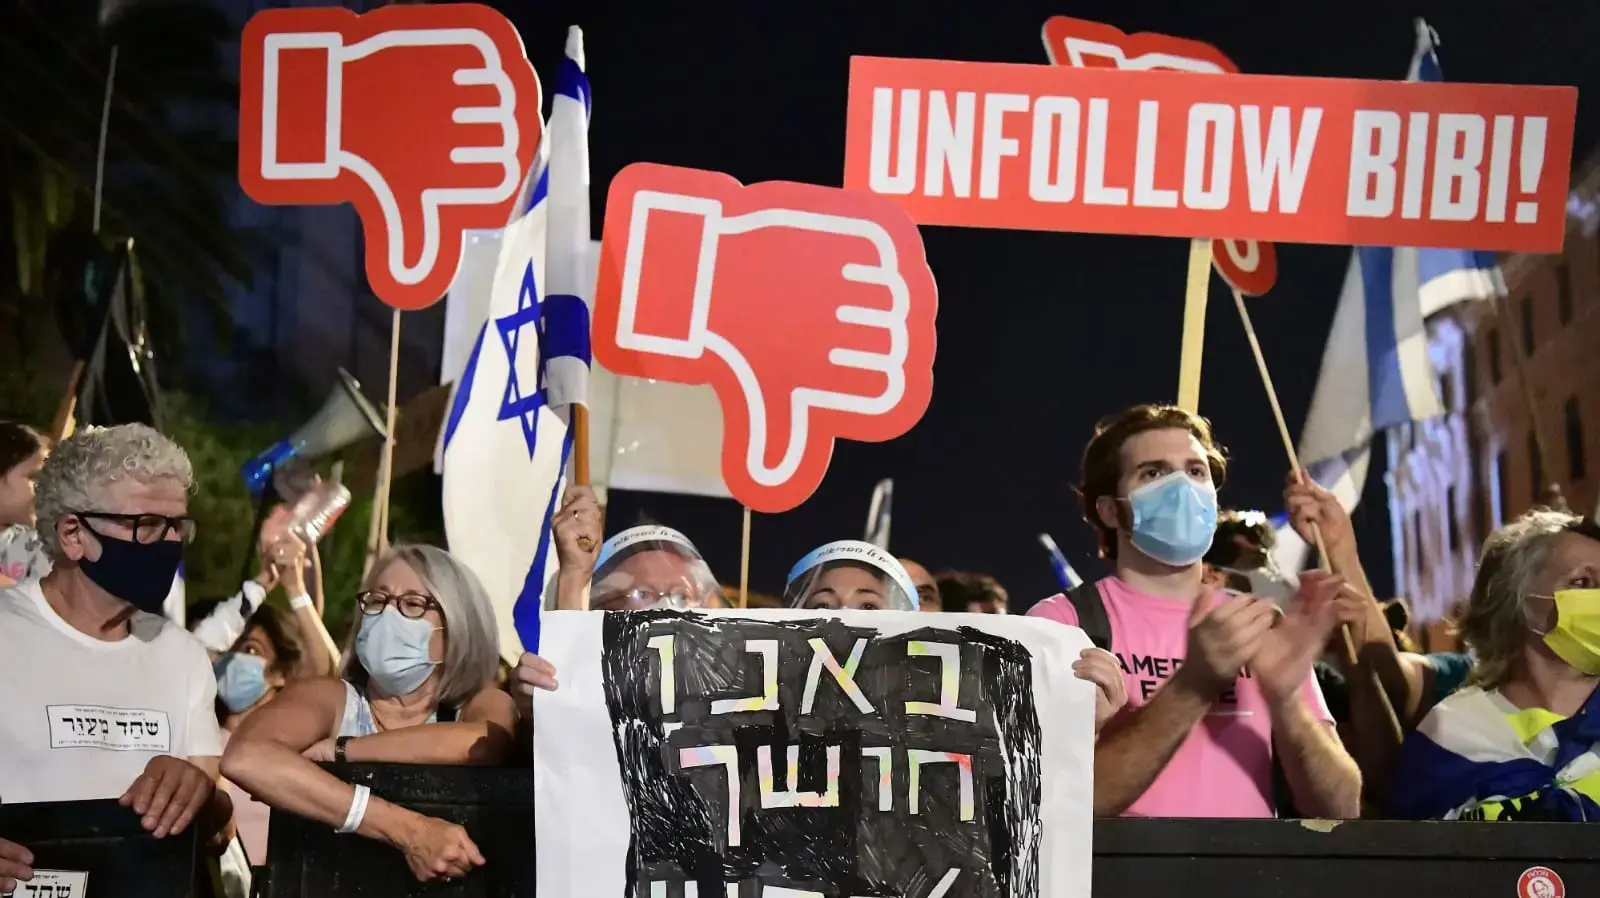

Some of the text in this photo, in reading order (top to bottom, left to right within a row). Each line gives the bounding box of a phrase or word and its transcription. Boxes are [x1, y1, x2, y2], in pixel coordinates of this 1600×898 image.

[868, 86, 1549, 224] UNFOLLOW BIBI!
[648, 634, 976, 723] באנו
[679, 744, 975, 847] חושך
